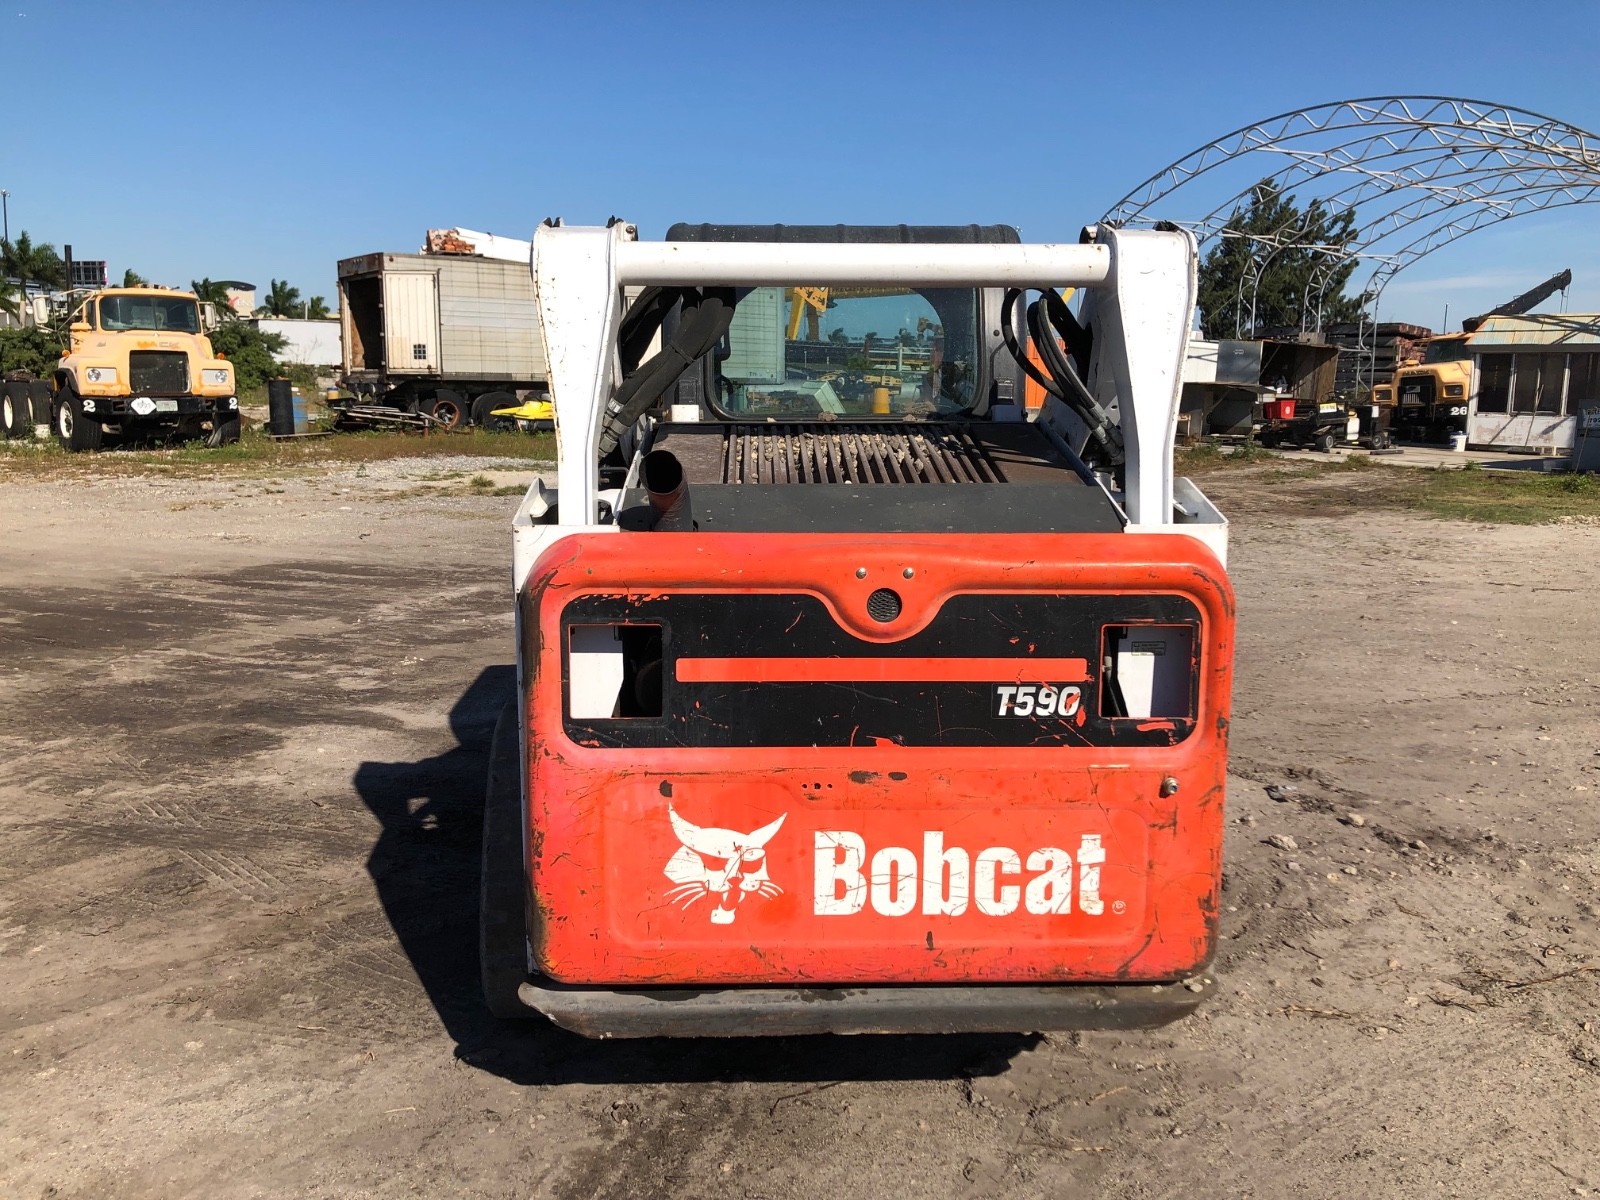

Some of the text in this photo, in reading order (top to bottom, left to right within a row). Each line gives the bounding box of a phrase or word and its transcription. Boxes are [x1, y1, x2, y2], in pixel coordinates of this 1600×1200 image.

[83, 399, 97, 413] 2
[229, 397, 239, 410] 2
[1450, 406, 1468, 417] 26
[996, 685, 1082, 717] T590
[813, 830, 1106, 917] Bobcat
